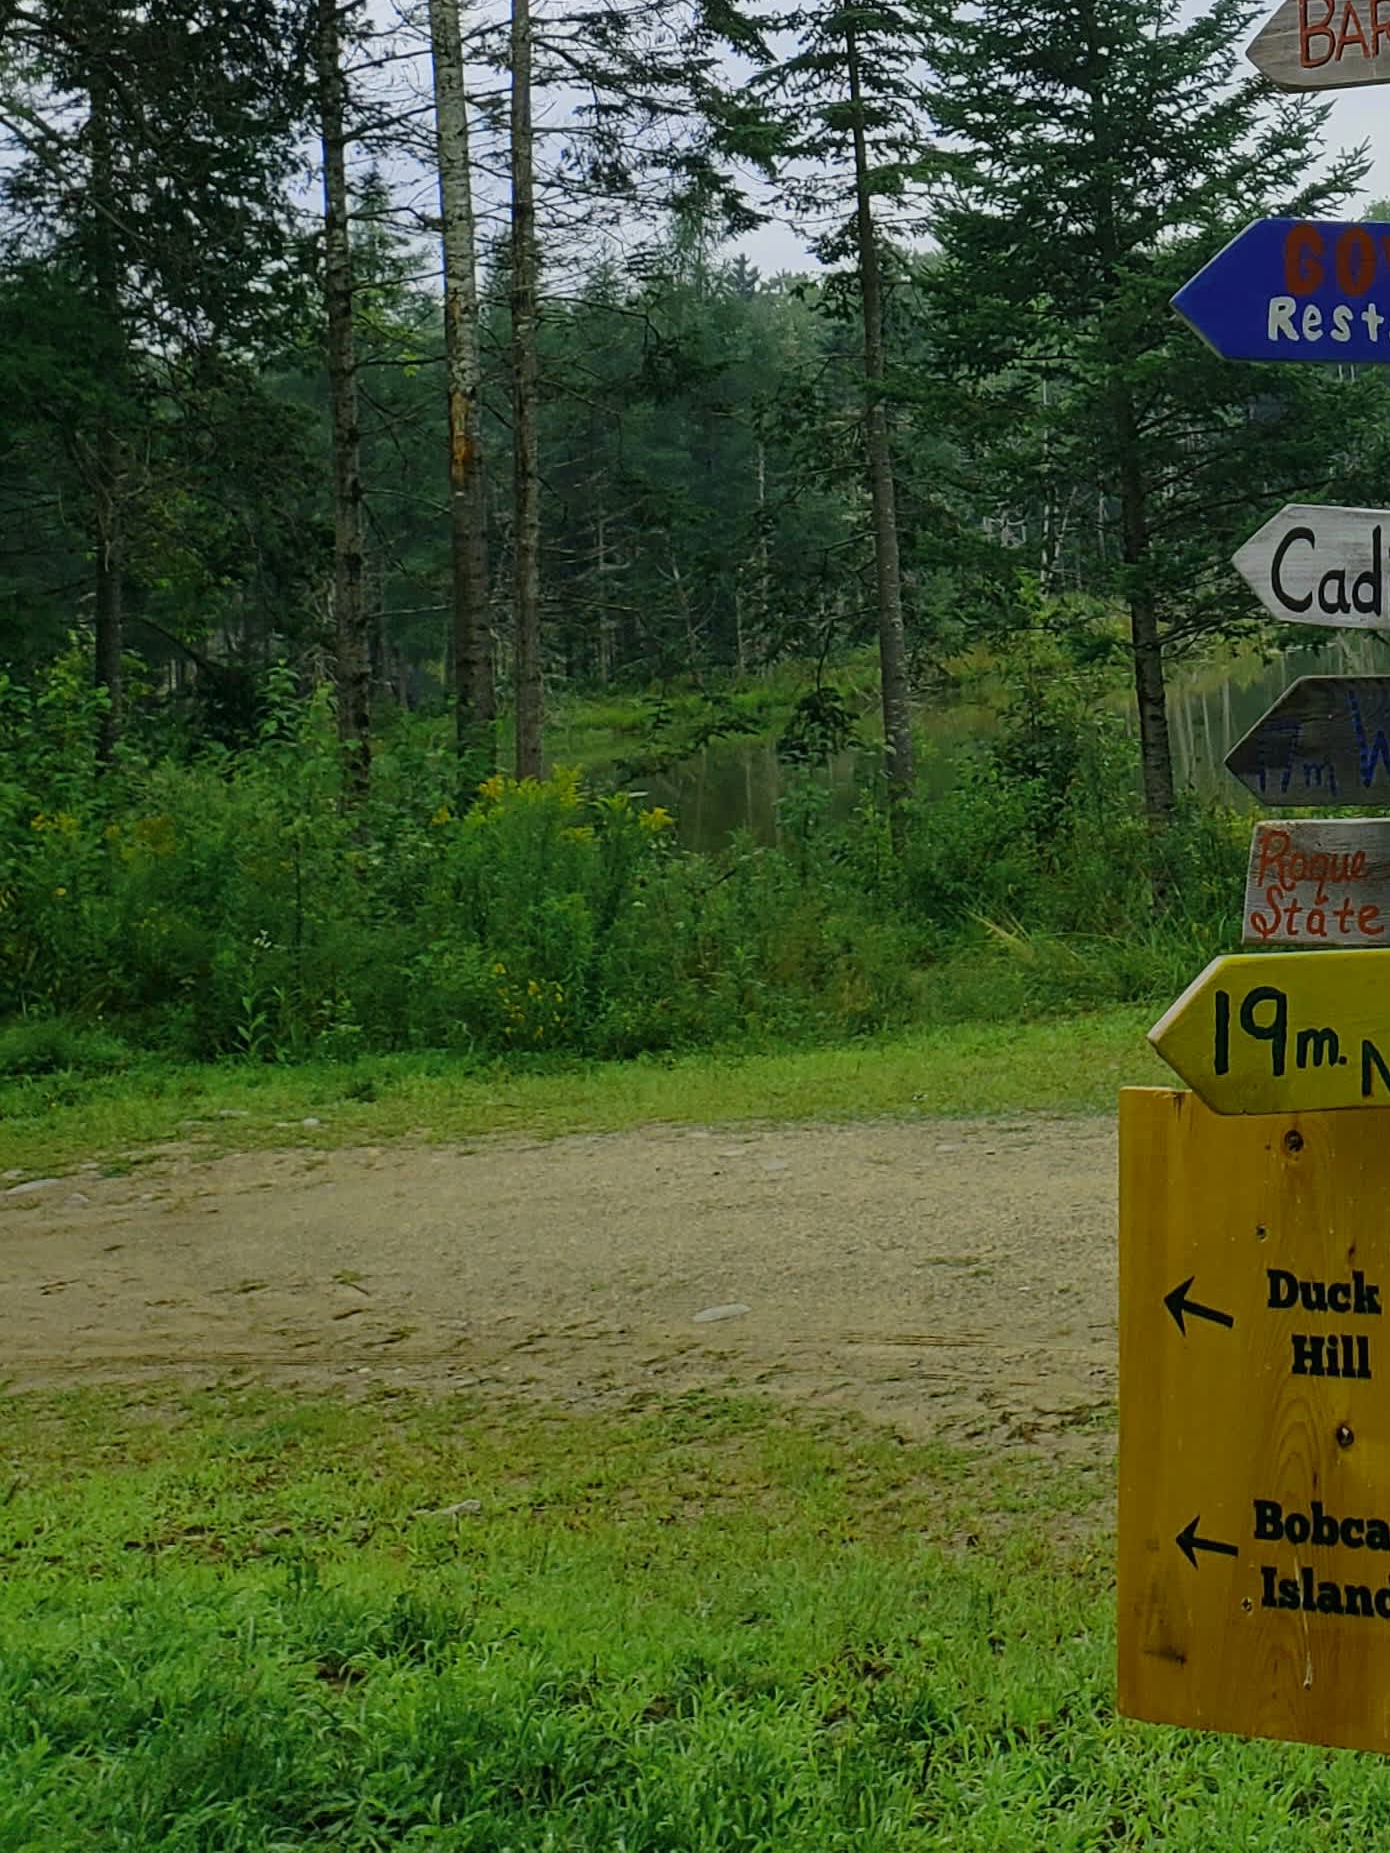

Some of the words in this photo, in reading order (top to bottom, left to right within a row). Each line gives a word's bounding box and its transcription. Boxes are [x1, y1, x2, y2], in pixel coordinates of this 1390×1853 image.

[1250, 887, 1385, 937] State
[1267, 1269, 1382, 1315] Duck
[1291, 1335, 1372, 1380] Hill
